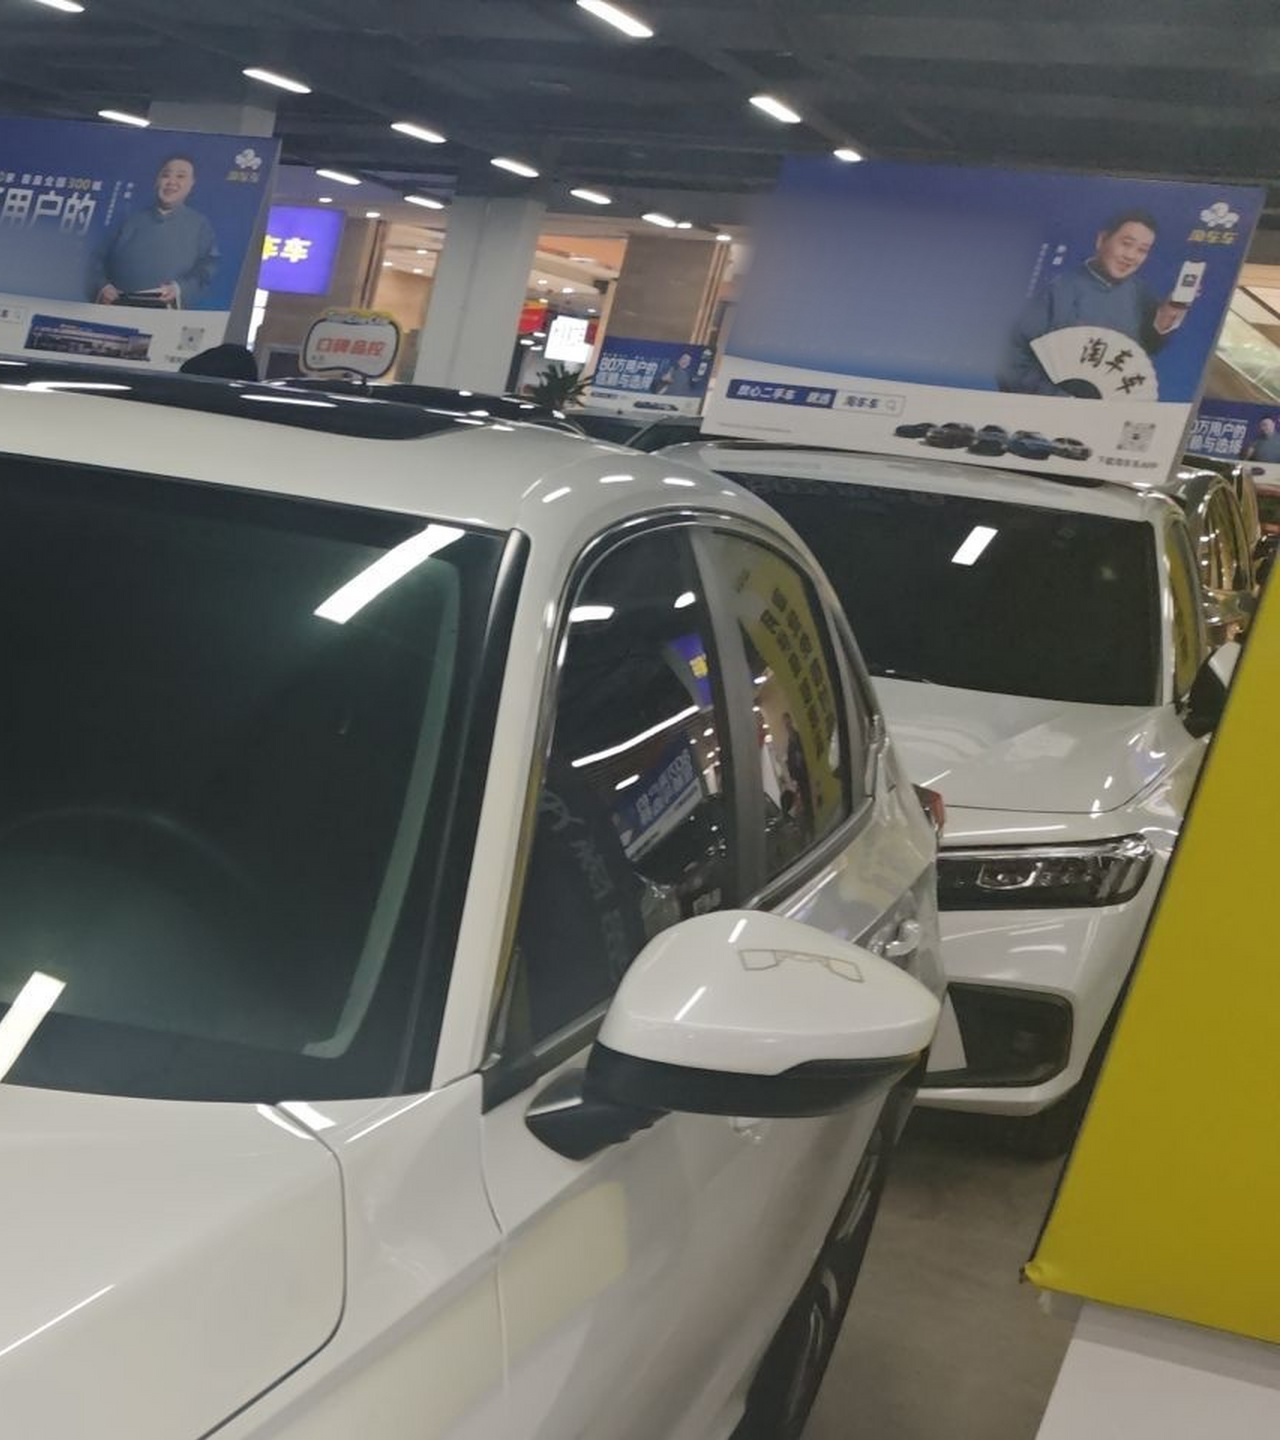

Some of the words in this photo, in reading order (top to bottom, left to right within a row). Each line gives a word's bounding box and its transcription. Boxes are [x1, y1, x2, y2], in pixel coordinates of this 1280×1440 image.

[1080, 338, 1146, 394] 淘车车
[736, 384, 797, 401] 放心二手车
